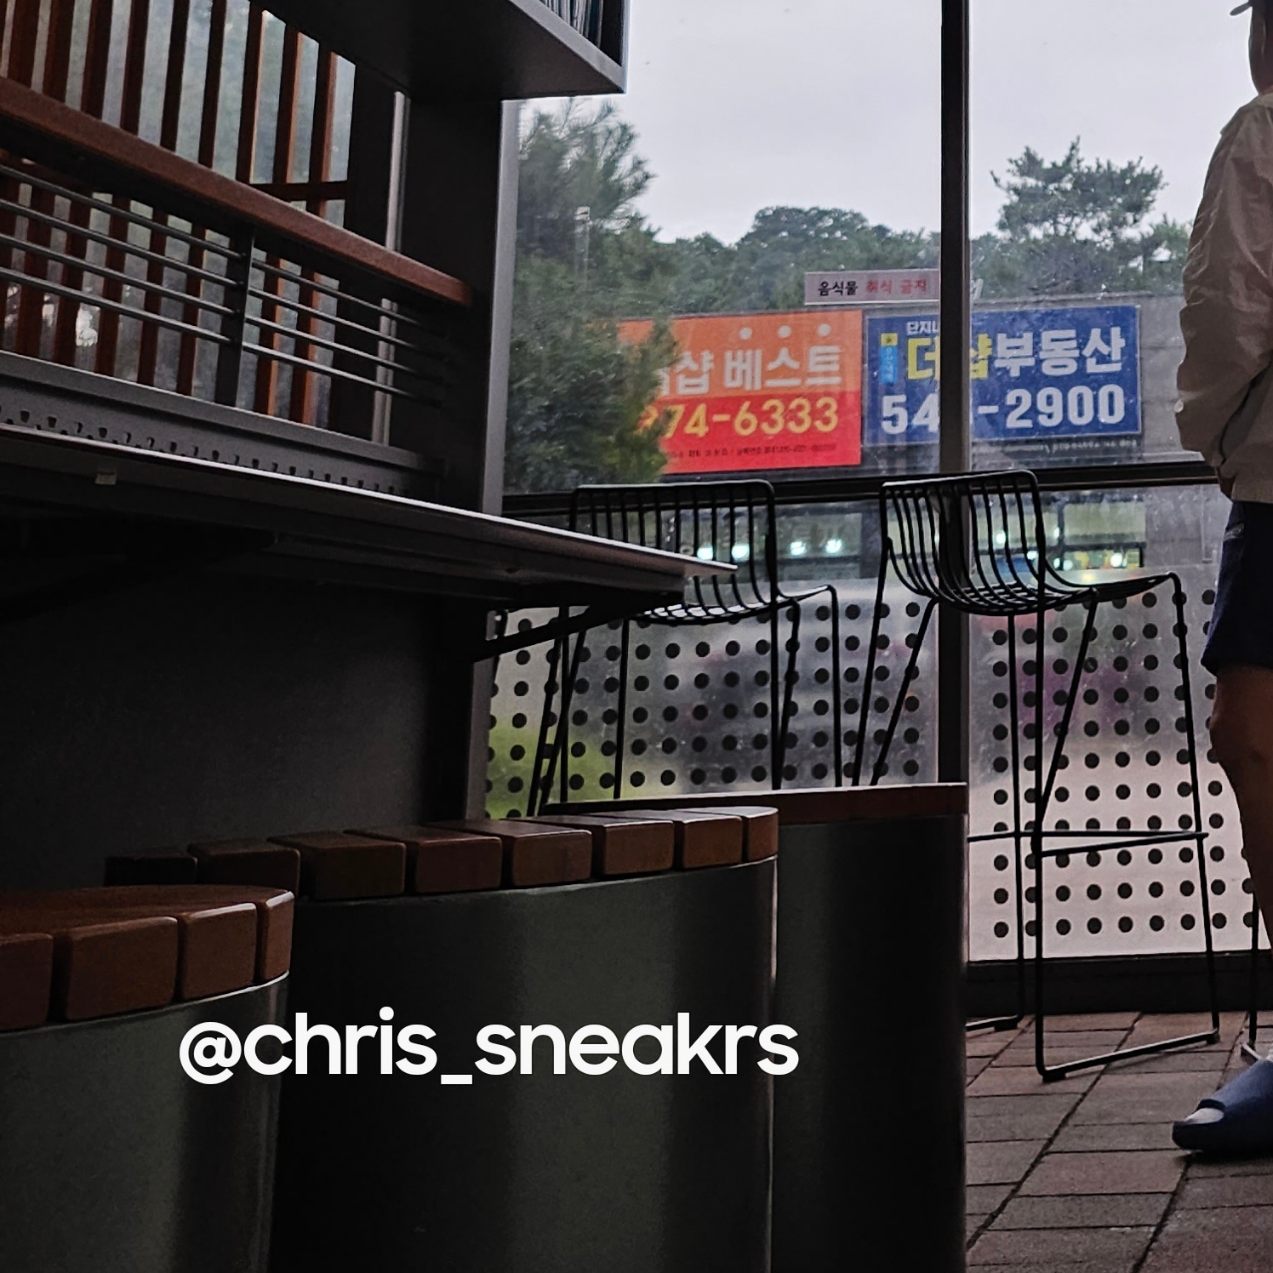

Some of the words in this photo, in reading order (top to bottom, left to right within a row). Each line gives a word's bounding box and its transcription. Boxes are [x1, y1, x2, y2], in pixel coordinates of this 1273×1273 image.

[817, 280, 859, 297] 음식물
[724, 345, 842, 391] 베스트
[881, 384, 1125, 435] 54-2900
